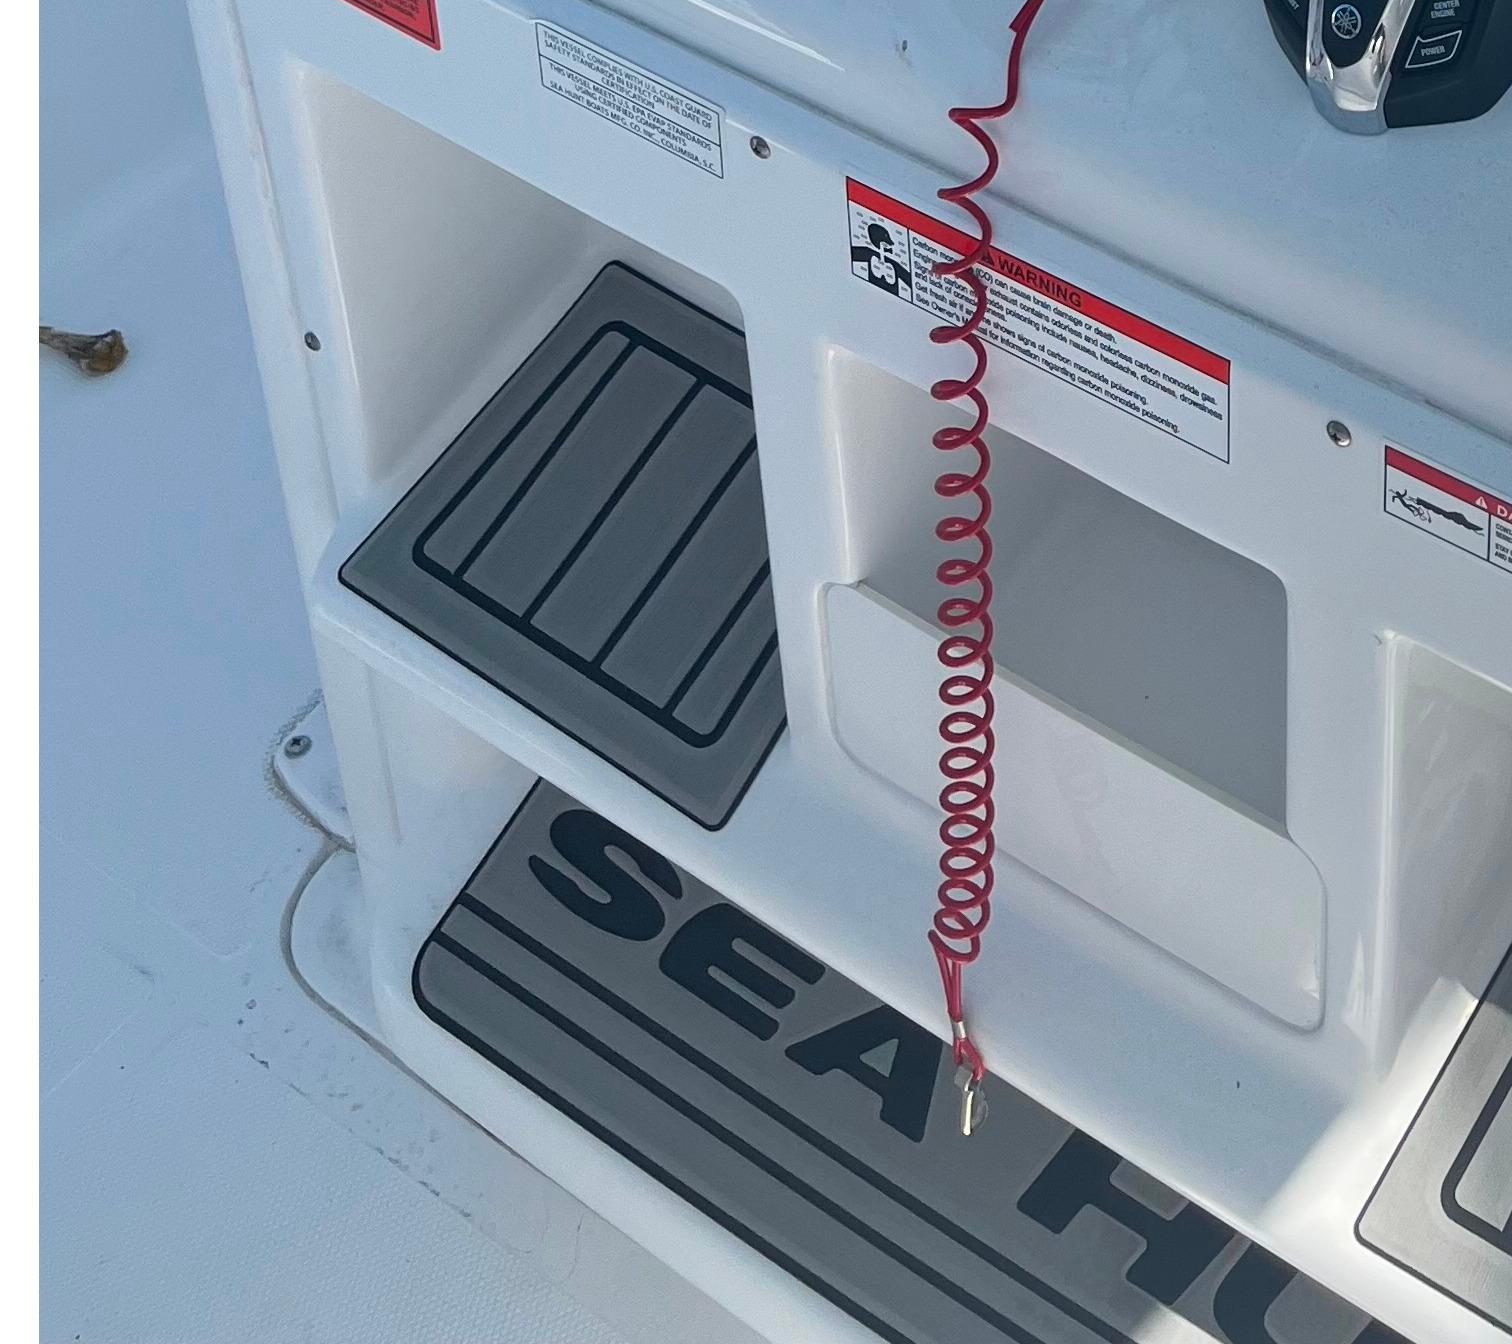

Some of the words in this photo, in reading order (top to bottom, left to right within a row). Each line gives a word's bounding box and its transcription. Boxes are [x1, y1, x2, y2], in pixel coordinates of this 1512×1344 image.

[1433, 0, 1460, 10] CENTER
[1420, 45, 1446, 57] POWER
[999, 256, 1082, 309] WARNING
[528, 807, 949, 1143] SEA
